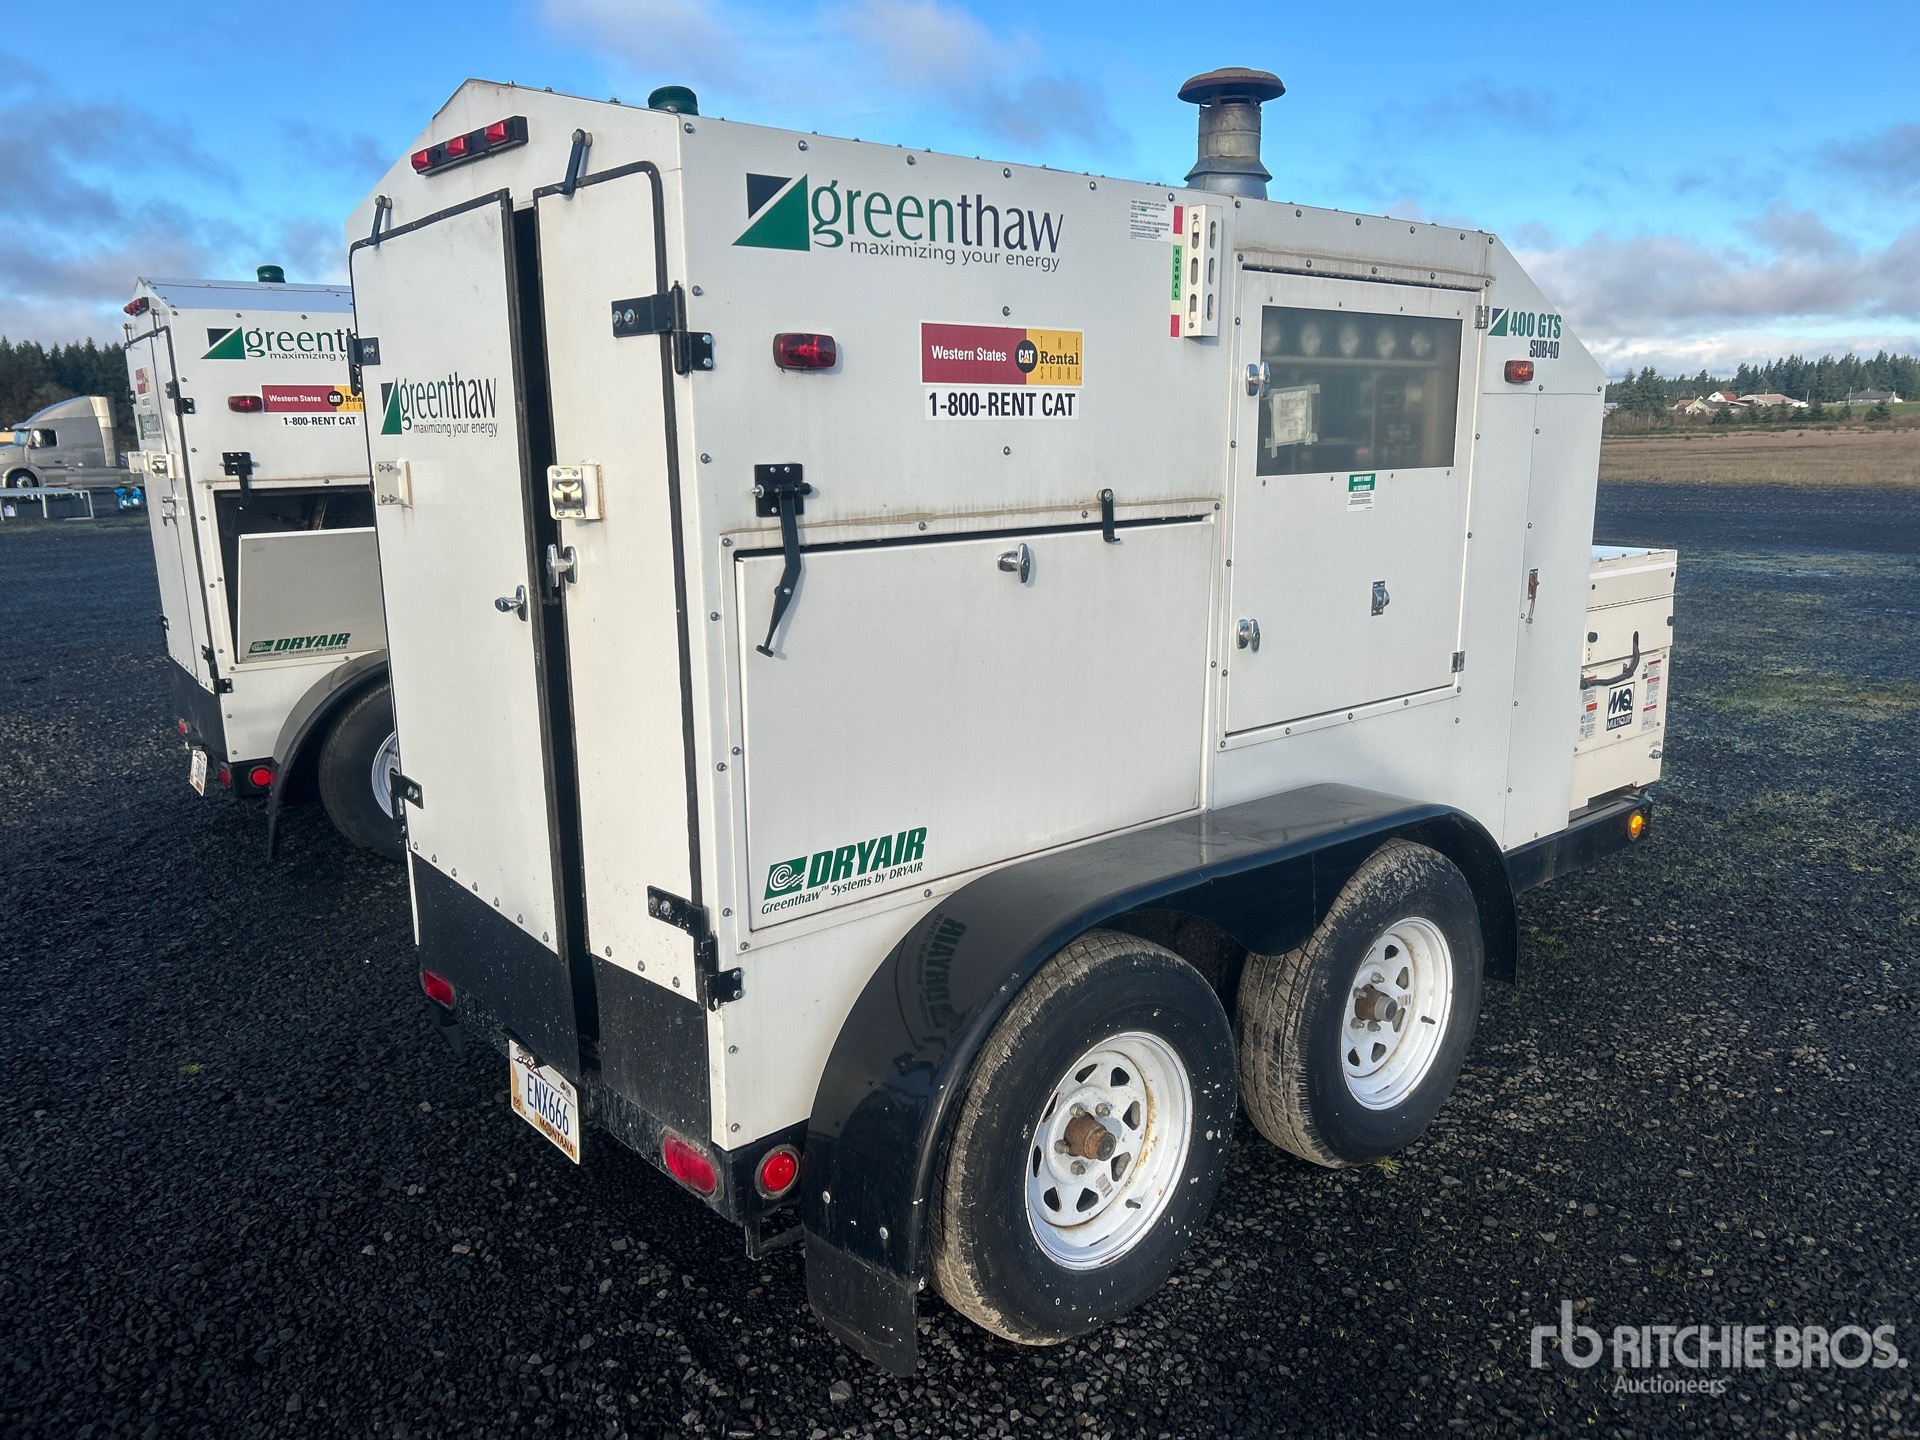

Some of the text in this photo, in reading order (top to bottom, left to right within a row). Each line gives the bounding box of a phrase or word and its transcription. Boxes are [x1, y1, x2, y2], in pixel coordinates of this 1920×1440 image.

[811, 180, 1064, 253] greenthaw
[850, 241, 1060, 273] maximizing your energy
[1509, 312, 1562, 339] 400 GTS
[1039, 336, 1079, 351] THE
[1529, 340, 1560, 359] SUB40
[270, 351, 337, 362] maximizing
[931, 345, 1079, 365] Western States CAT Rental
[268, 394, 299, 402] Western
[299, 394, 322, 403] States
[329, 394, 342, 403] CAT
[400, 371, 497, 431] greenthaw
[929, 392, 1076, 417] 1-800-RENT CAT
[282, 416, 357, 426] 1-800-RENT CAT
[413, 420, 498, 438] maximizing your energy
[274, 633, 352, 651] DRYAIR
[1607, 713, 1632, 729] MULTIQUIP
[806, 826, 928, 890] DRYAIR
[830, 875, 872, 897] Systems
[874, 872, 887, 884] by
[888, 861, 924, 880] DRYAIR
[527, 1072, 569, 1136] ENX666
[538, 1117, 575, 1156] MONTANA
